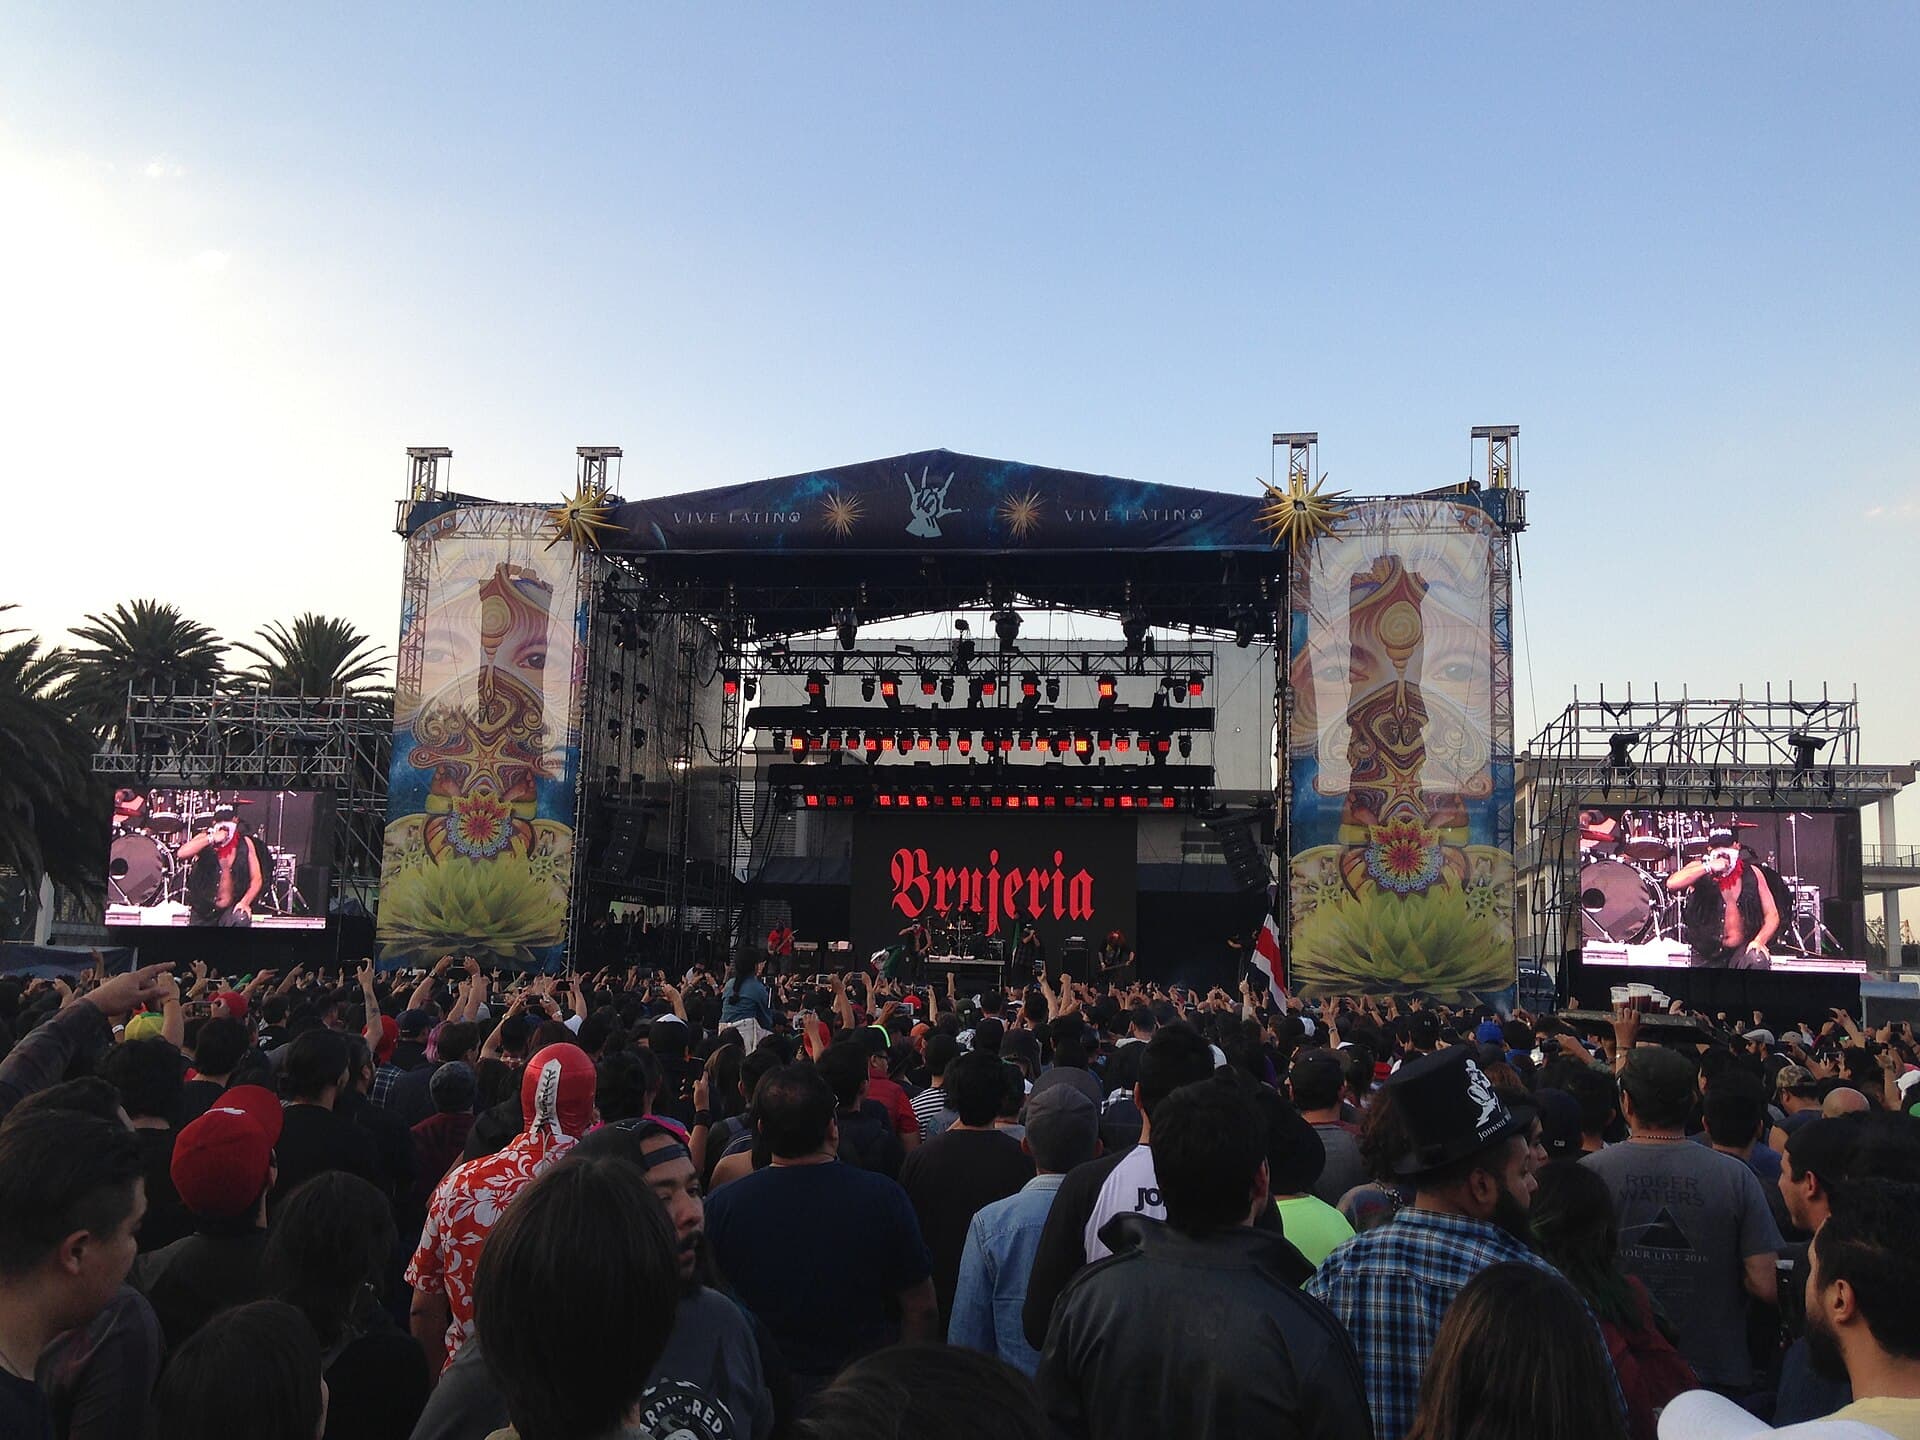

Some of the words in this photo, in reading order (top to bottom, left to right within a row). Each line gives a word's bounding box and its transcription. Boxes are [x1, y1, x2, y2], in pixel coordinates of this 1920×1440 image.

[673, 511, 719, 524] VIVE
[728, 511, 801, 524] LATINO
[1064, 509, 1113, 522] VIVE
[1126, 508, 1203, 521] LATINO
[890, 848, 1095, 937] Brujeria
[1625, 1174, 1698, 1191] ROGER
[1619, 1188, 1705, 1206] WATERS
